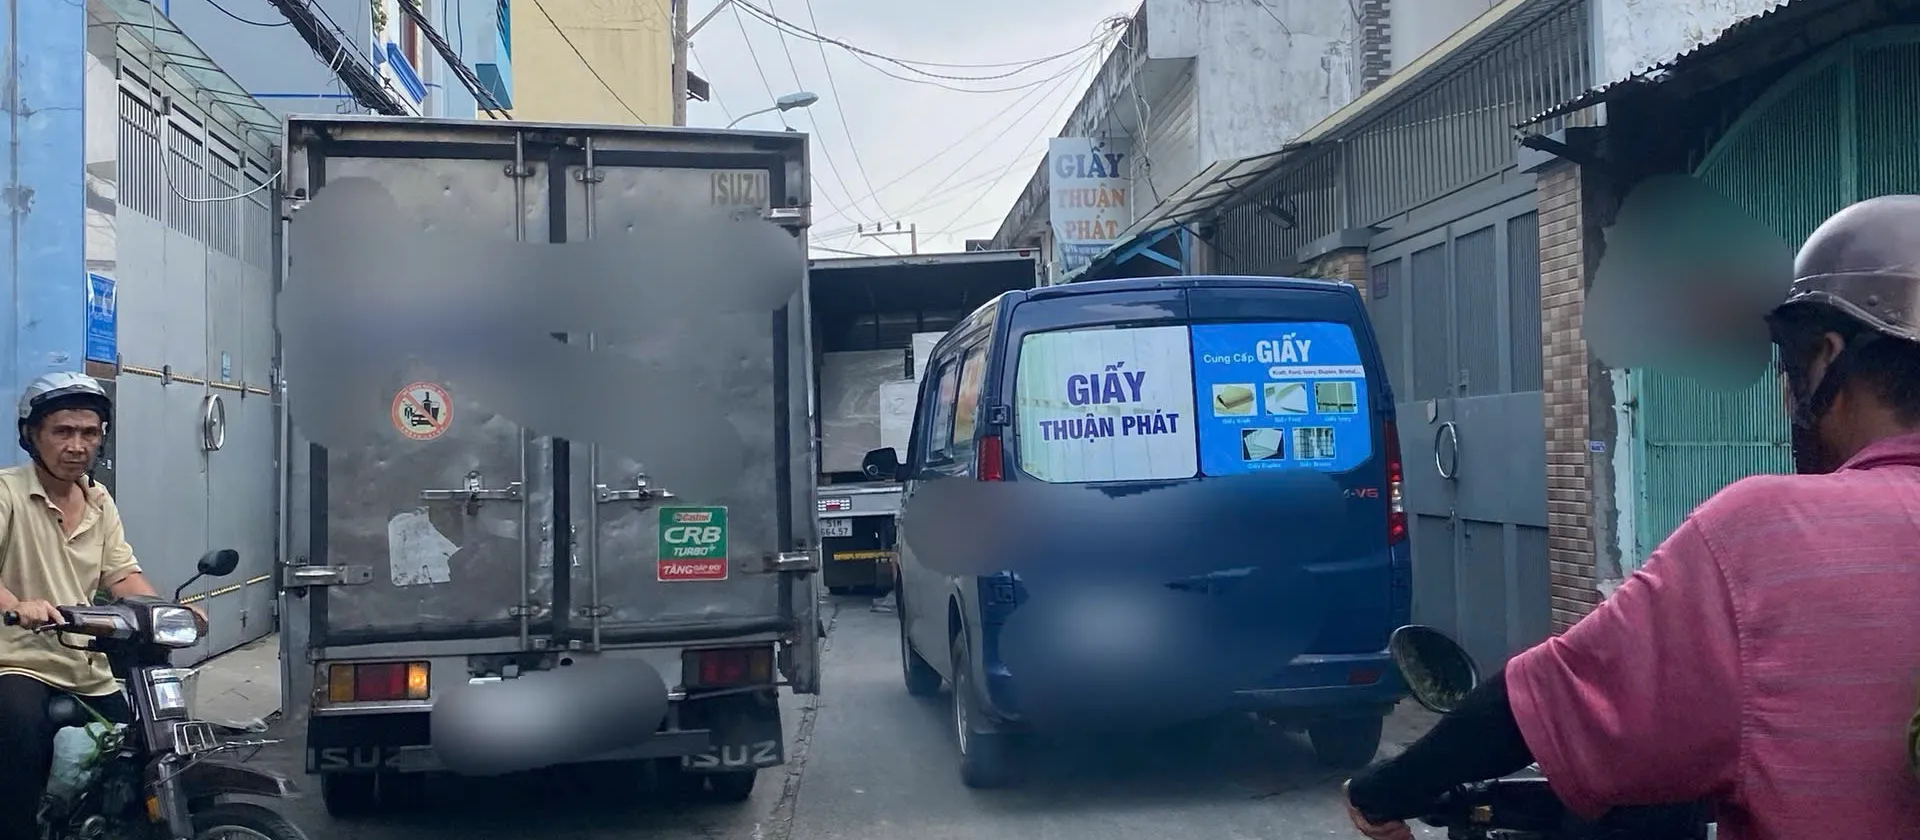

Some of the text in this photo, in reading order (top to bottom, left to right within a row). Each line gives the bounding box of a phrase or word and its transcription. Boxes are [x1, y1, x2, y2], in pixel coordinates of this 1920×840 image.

[1055, 142, 1124, 178] GIẤY
[710, 172, 770, 206] ISUZU
[1057, 183, 1125, 213] THUẬN
[1065, 215, 1118, 240] PHÁT
[1203, 332, 1311, 365] Cung Cấp GIẤY
[1067, 361, 1146, 406] GIẤY
[1039, 409, 1180, 443] THUẬN PHÁT
[664, 526, 722, 545] CRB
